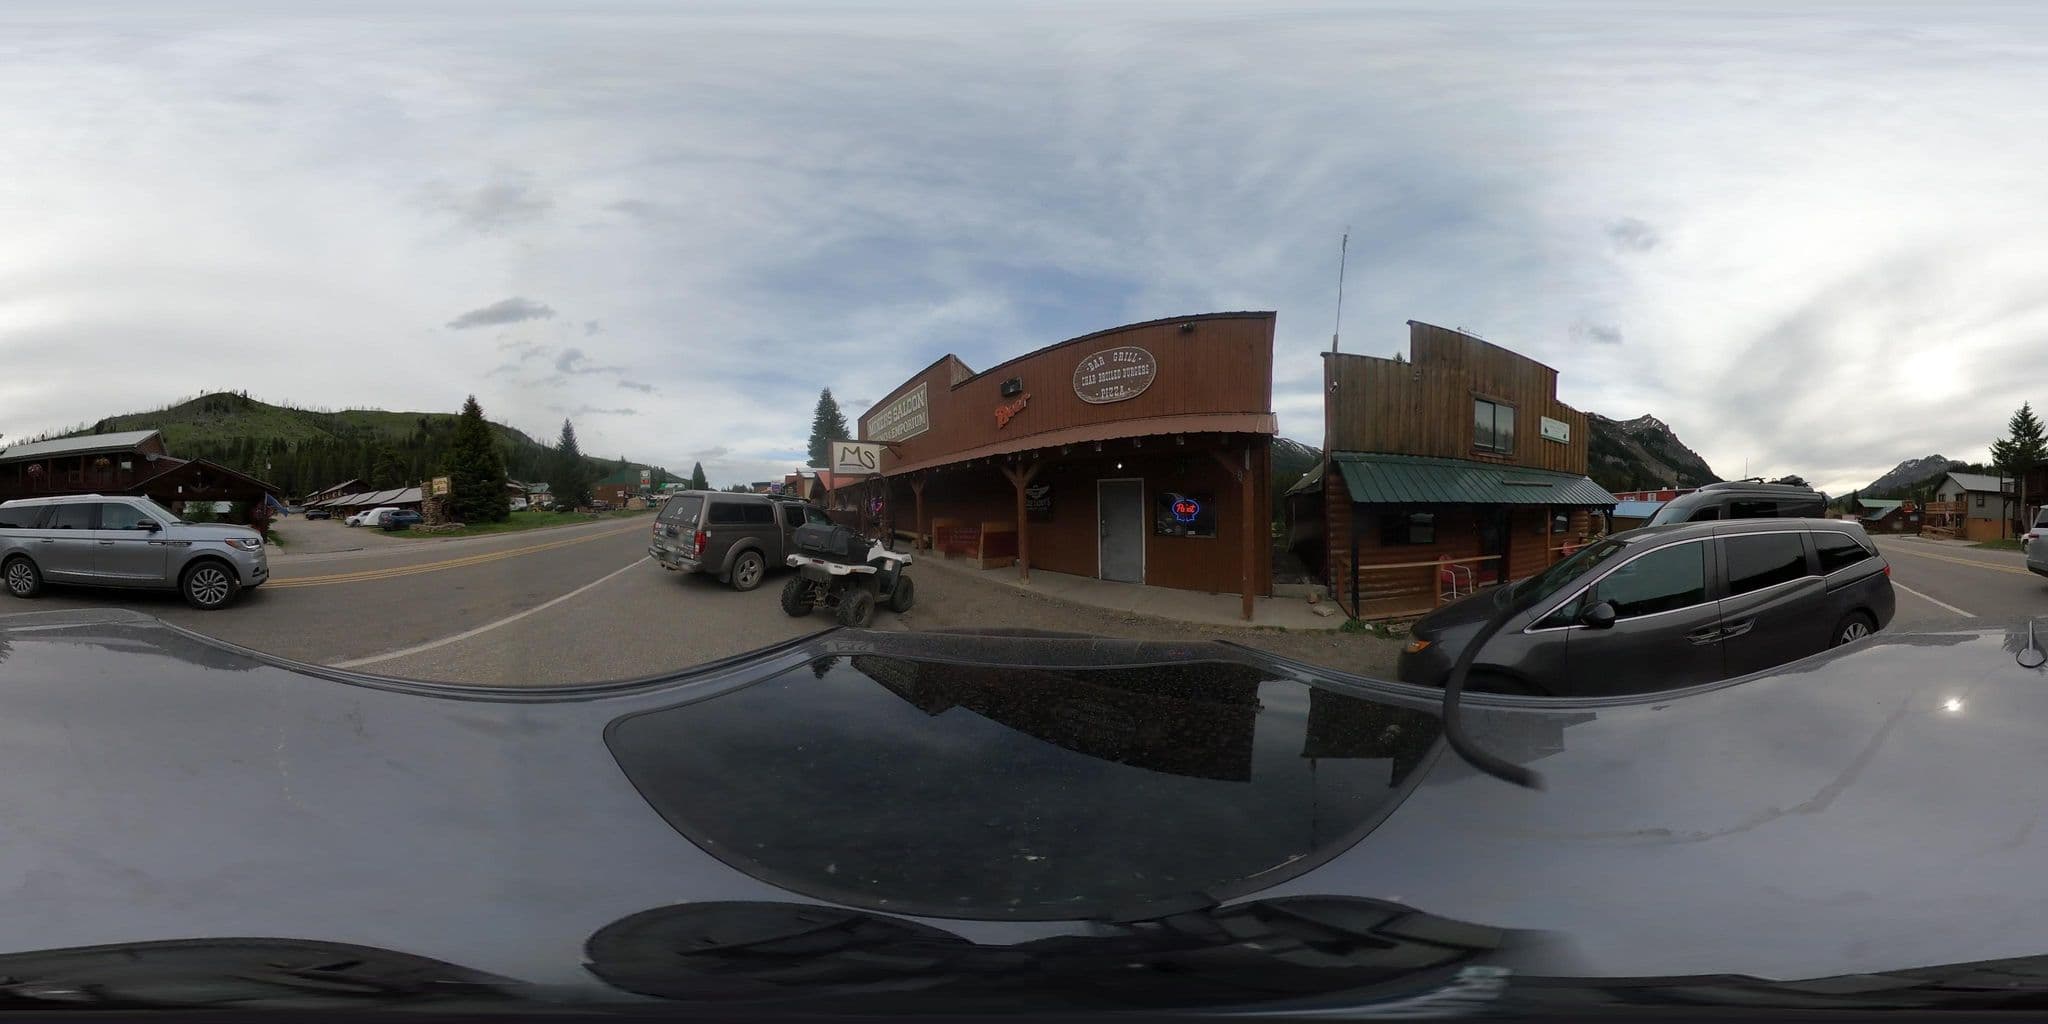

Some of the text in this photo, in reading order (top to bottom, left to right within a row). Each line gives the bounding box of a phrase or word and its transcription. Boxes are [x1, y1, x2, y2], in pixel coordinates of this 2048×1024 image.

[1088, 351, 1138, 372] BAR GRILL
[1081, 363, 1151, 387] CHAR BROILED BURGERS
[1101, 385, 1126, 399] PIZZA
[892, 389, 925, 421] SALOON
[1176, 503, 1197, 513] Past
